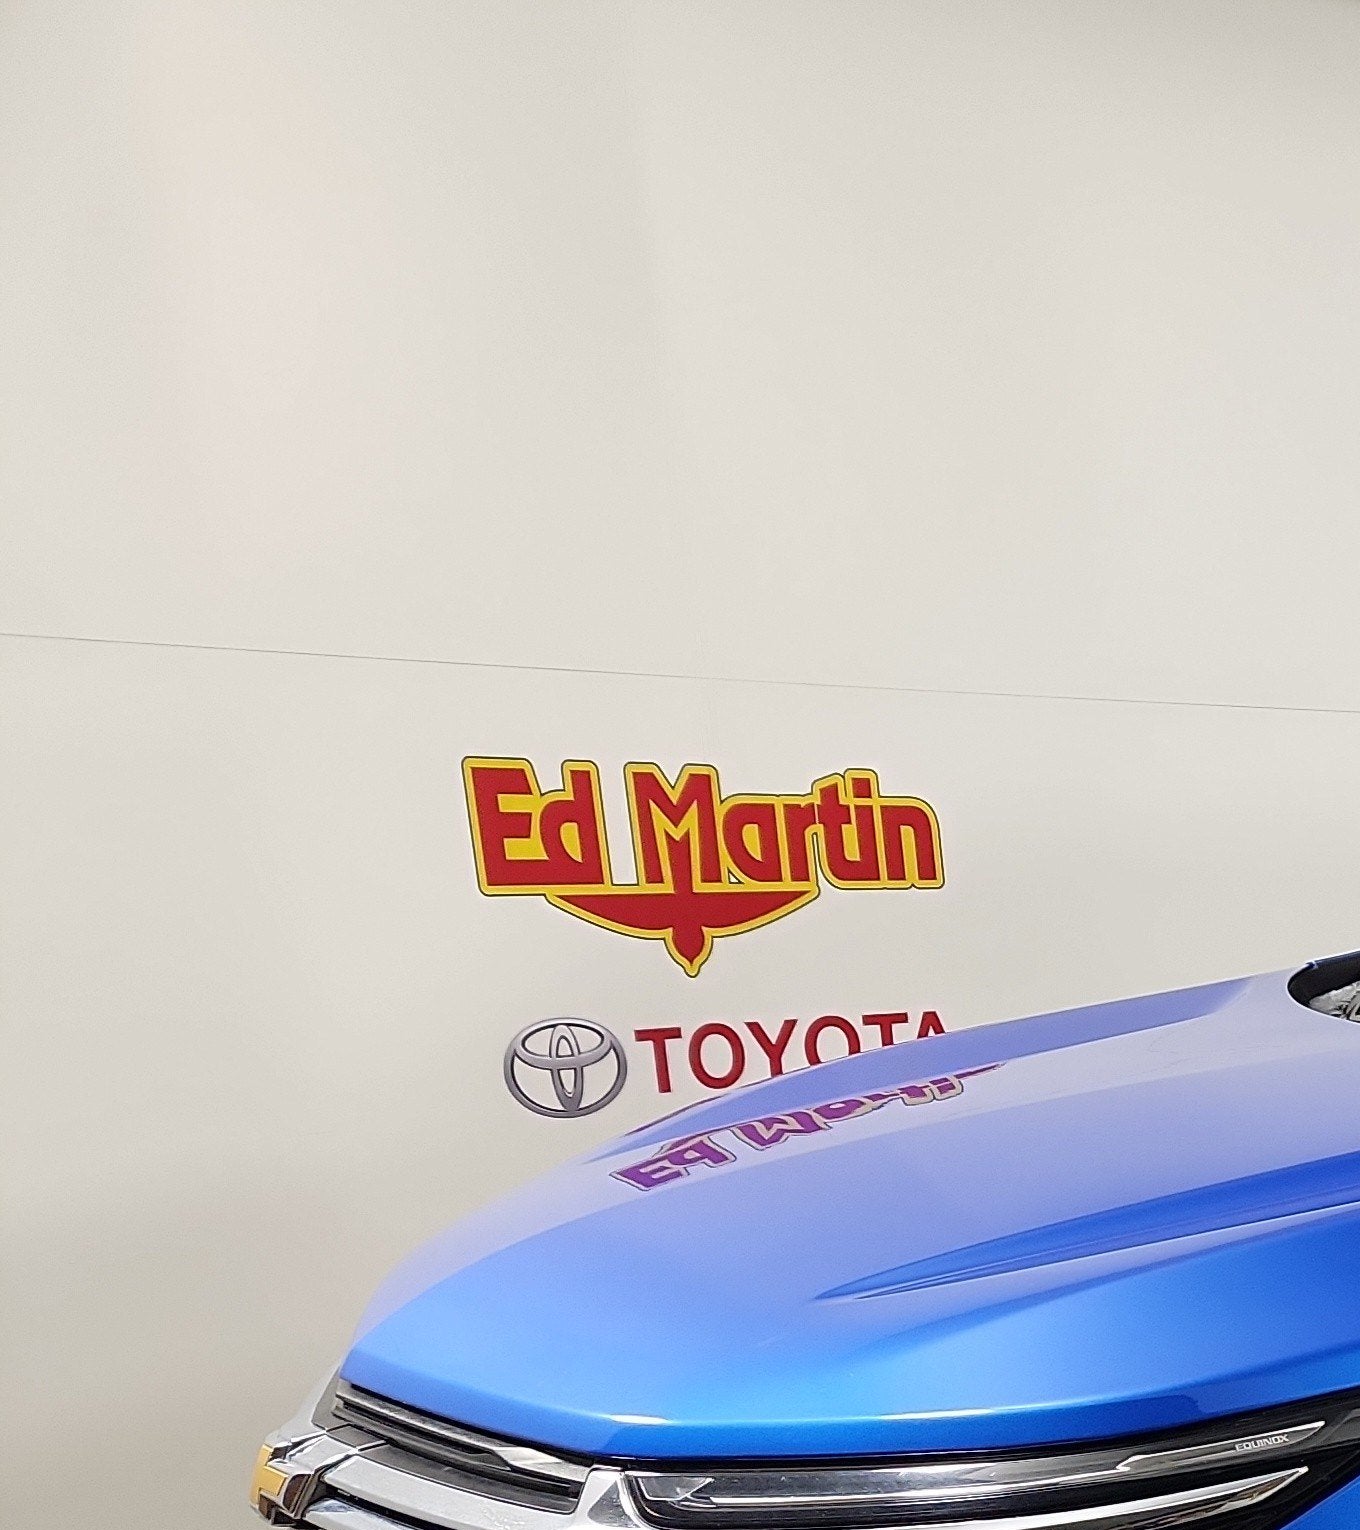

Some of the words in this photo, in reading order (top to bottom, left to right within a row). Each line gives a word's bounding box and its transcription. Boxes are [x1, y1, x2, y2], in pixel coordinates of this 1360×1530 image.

[469, 765, 608, 888] Ed
[630, 770, 938, 886] Martin
[1235, 1434, 1289, 1451] EQUINOX
